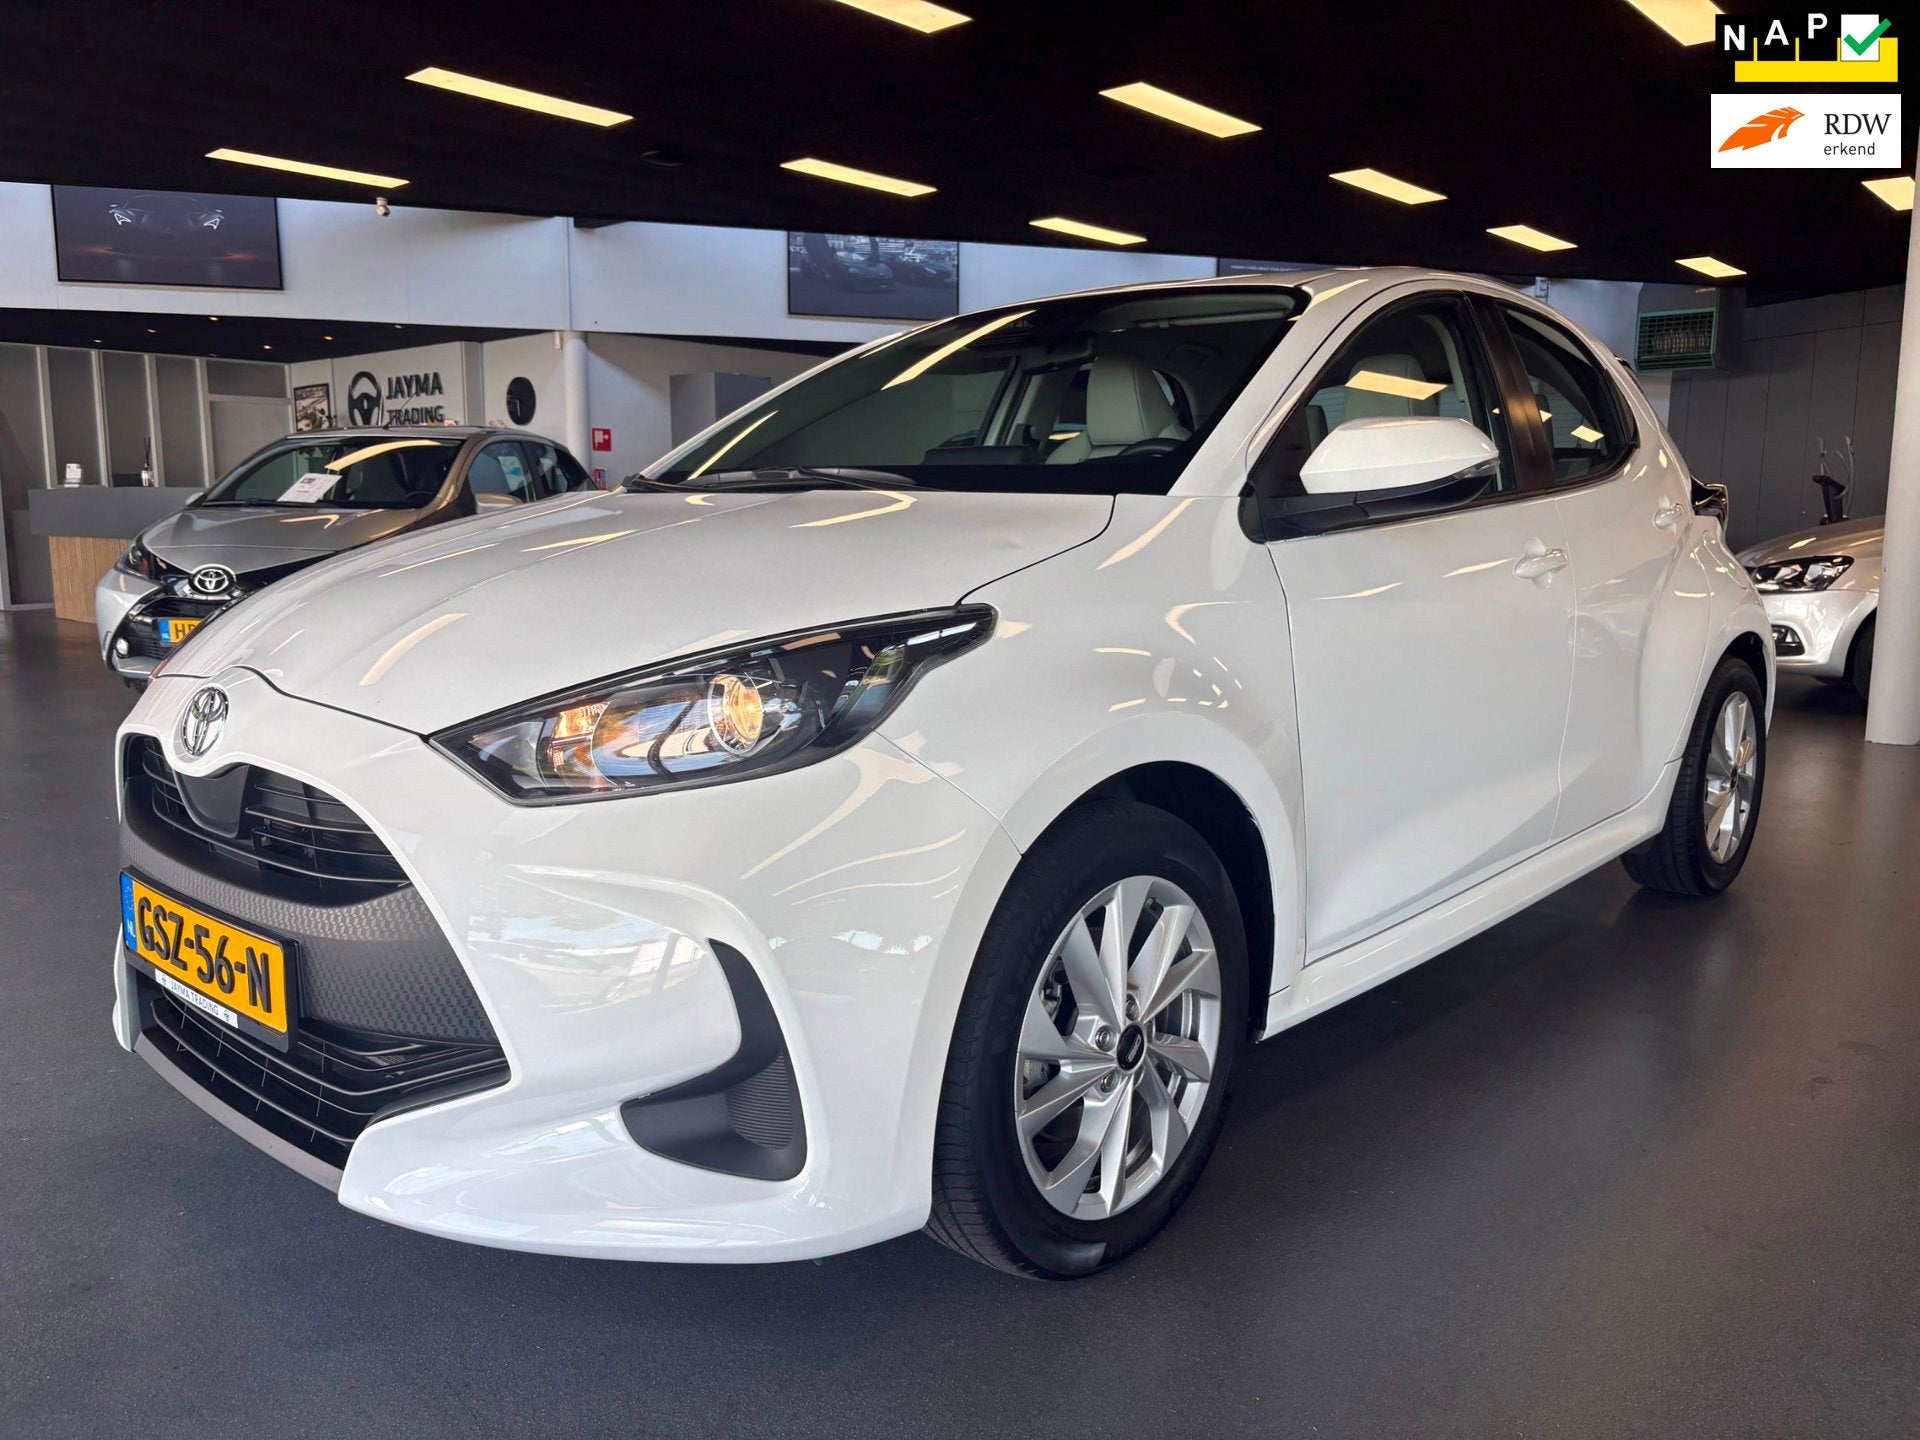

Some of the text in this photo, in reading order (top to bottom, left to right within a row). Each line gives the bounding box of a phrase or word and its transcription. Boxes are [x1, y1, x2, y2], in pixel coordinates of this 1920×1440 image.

[385, 372, 444, 400] JAYMA
[386, 405, 445, 425] TRADING
[137, 896, 272, 1014] GSZ-56-N
[171, 980, 219, 1015] JAYMA TRADING
